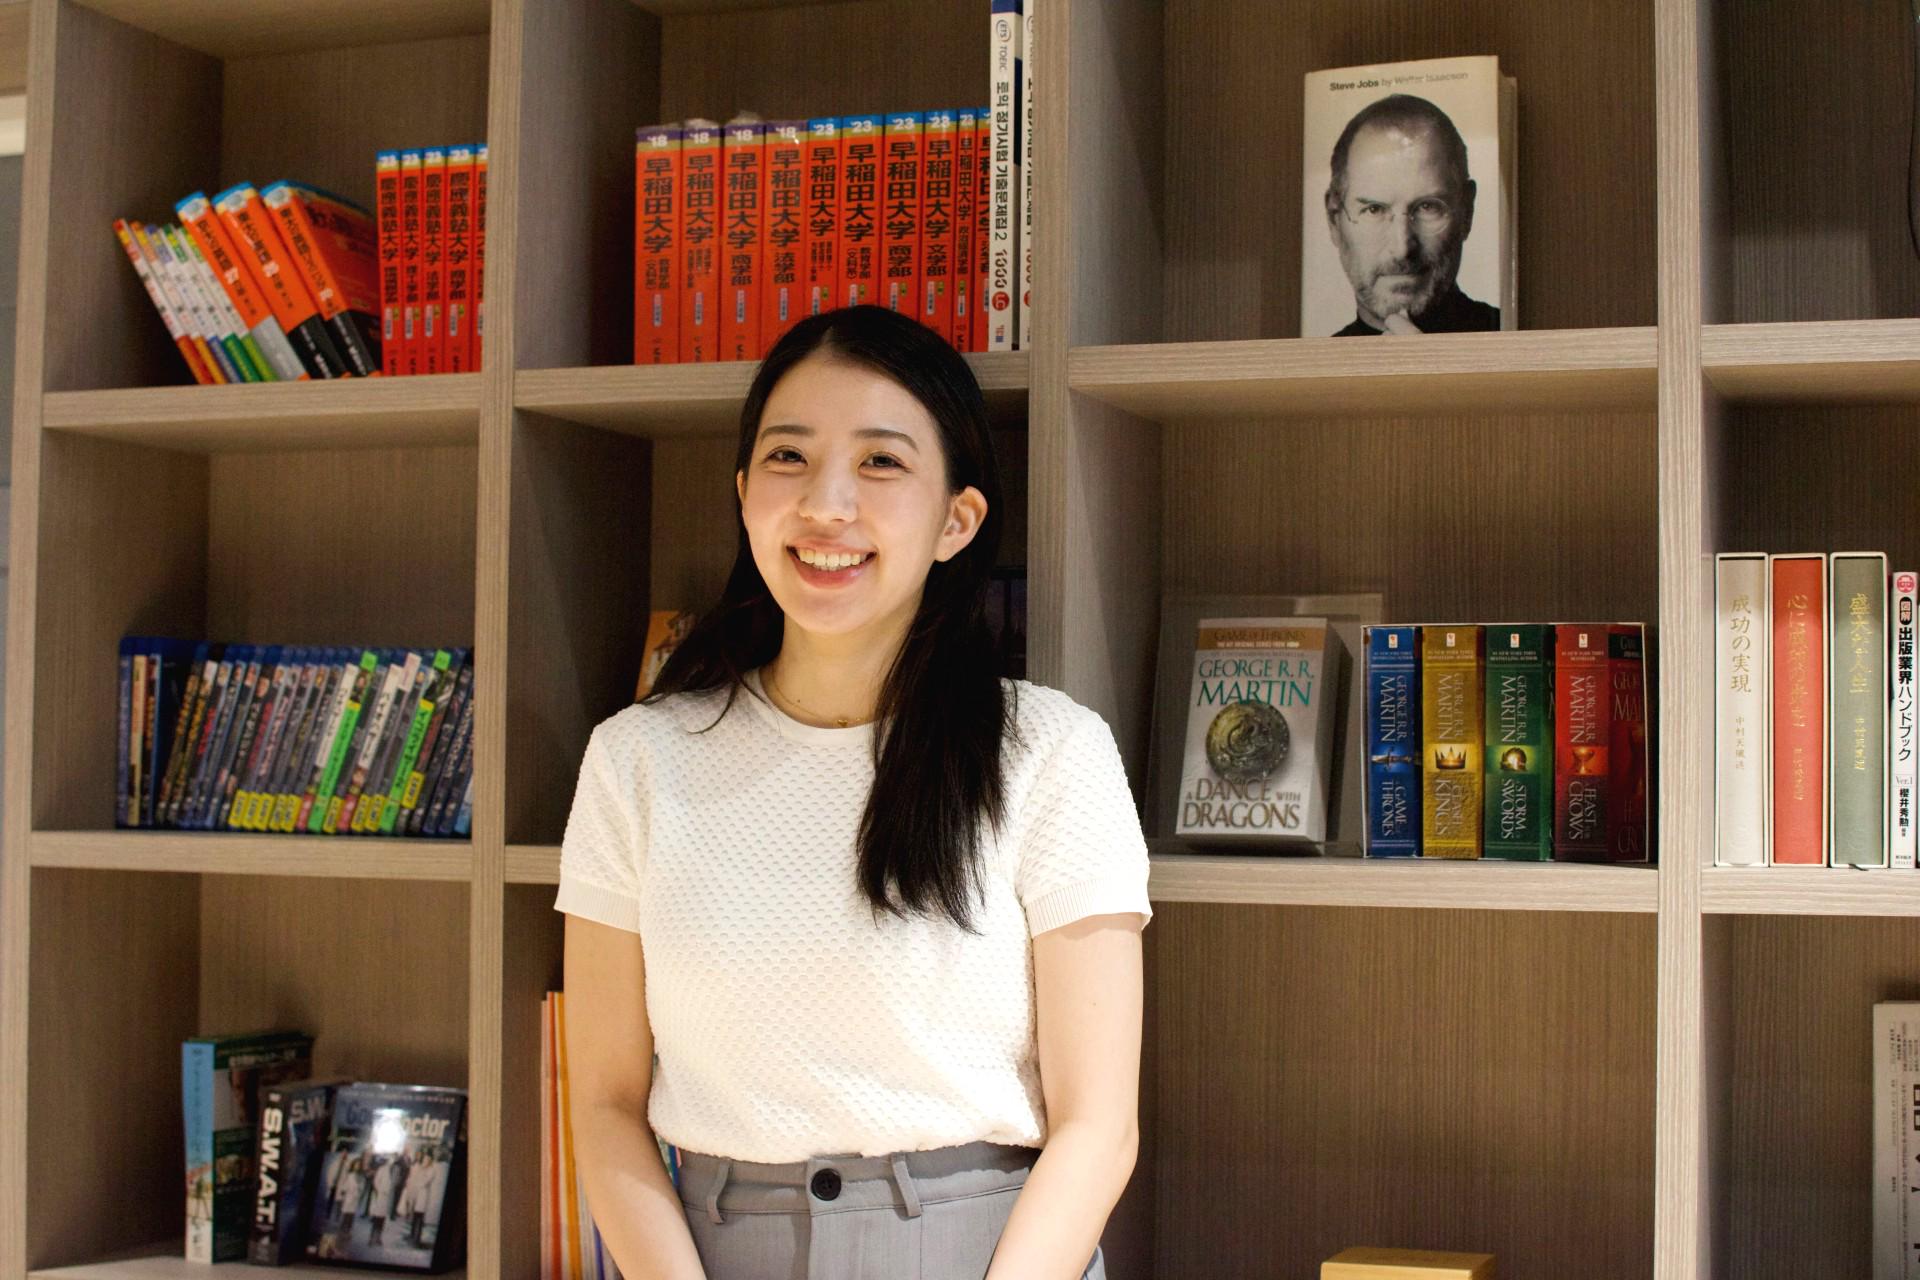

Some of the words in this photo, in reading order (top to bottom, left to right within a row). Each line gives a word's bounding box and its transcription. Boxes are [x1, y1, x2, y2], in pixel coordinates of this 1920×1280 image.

[1329, 82, 1355, 92] Steve
[1357, 79, 1379, 89] Jobs
[647, 134, 668, 148] '18
[689, 131, 710, 145] '18
[732, 129, 753, 142] '18
[851, 120, 873, 132] '23
[892, 117, 915, 130] '23
[996, 111, 1009, 162] 정기시험
[643, 158, 673, 254] 早稲田大学
[685, 154, 715, 244] 早稲田大学
[727, 152, 758, 249] 早稲田大学
[769, 149, 802, 247] 早稲田大学
[809, 146, 837, 237] 早稲田大学
[844, 143, 877, 242] 早稲田大学
[885, 141, 918, 240] 早稲田大学
[925, 139, 952, 239] 早稲田大学
[957, 136, 973, 221] 早稲田大学
[926, 243, 947, 277] 文学部
[1198, 659, 1273, 678] GEORGE
[1730, 594, 1752, 693] 成功の実現
[1197, 680, 1312, 706] MARTIN
[1380, 675, 1396, 742] MARTIN
[1437, 673, 1453, 740] MARTIN
[1501, 675, 1516, 743] MARTIN
[1569, 675, 1585, 743] MARTIN
[1898, 626, 1913, 762] 出版業界ハンドブック
[1183, 802, 1301, 829] DRAGONS
[1195, 778, 1273, 802] DANCE
[1381, 779, 1394, 837] THRONES
[1435, 779, 1452, 836] KINGS
[1500, 778, 1515, 839] SWORDS
[1515, 784, 1527, 830] STORM
[1568, 780, 1584, 840] CROWS
[1584, 787, 1597, 825] FEAST
[256, 1107, 283, 1224] S.W.A.T.
